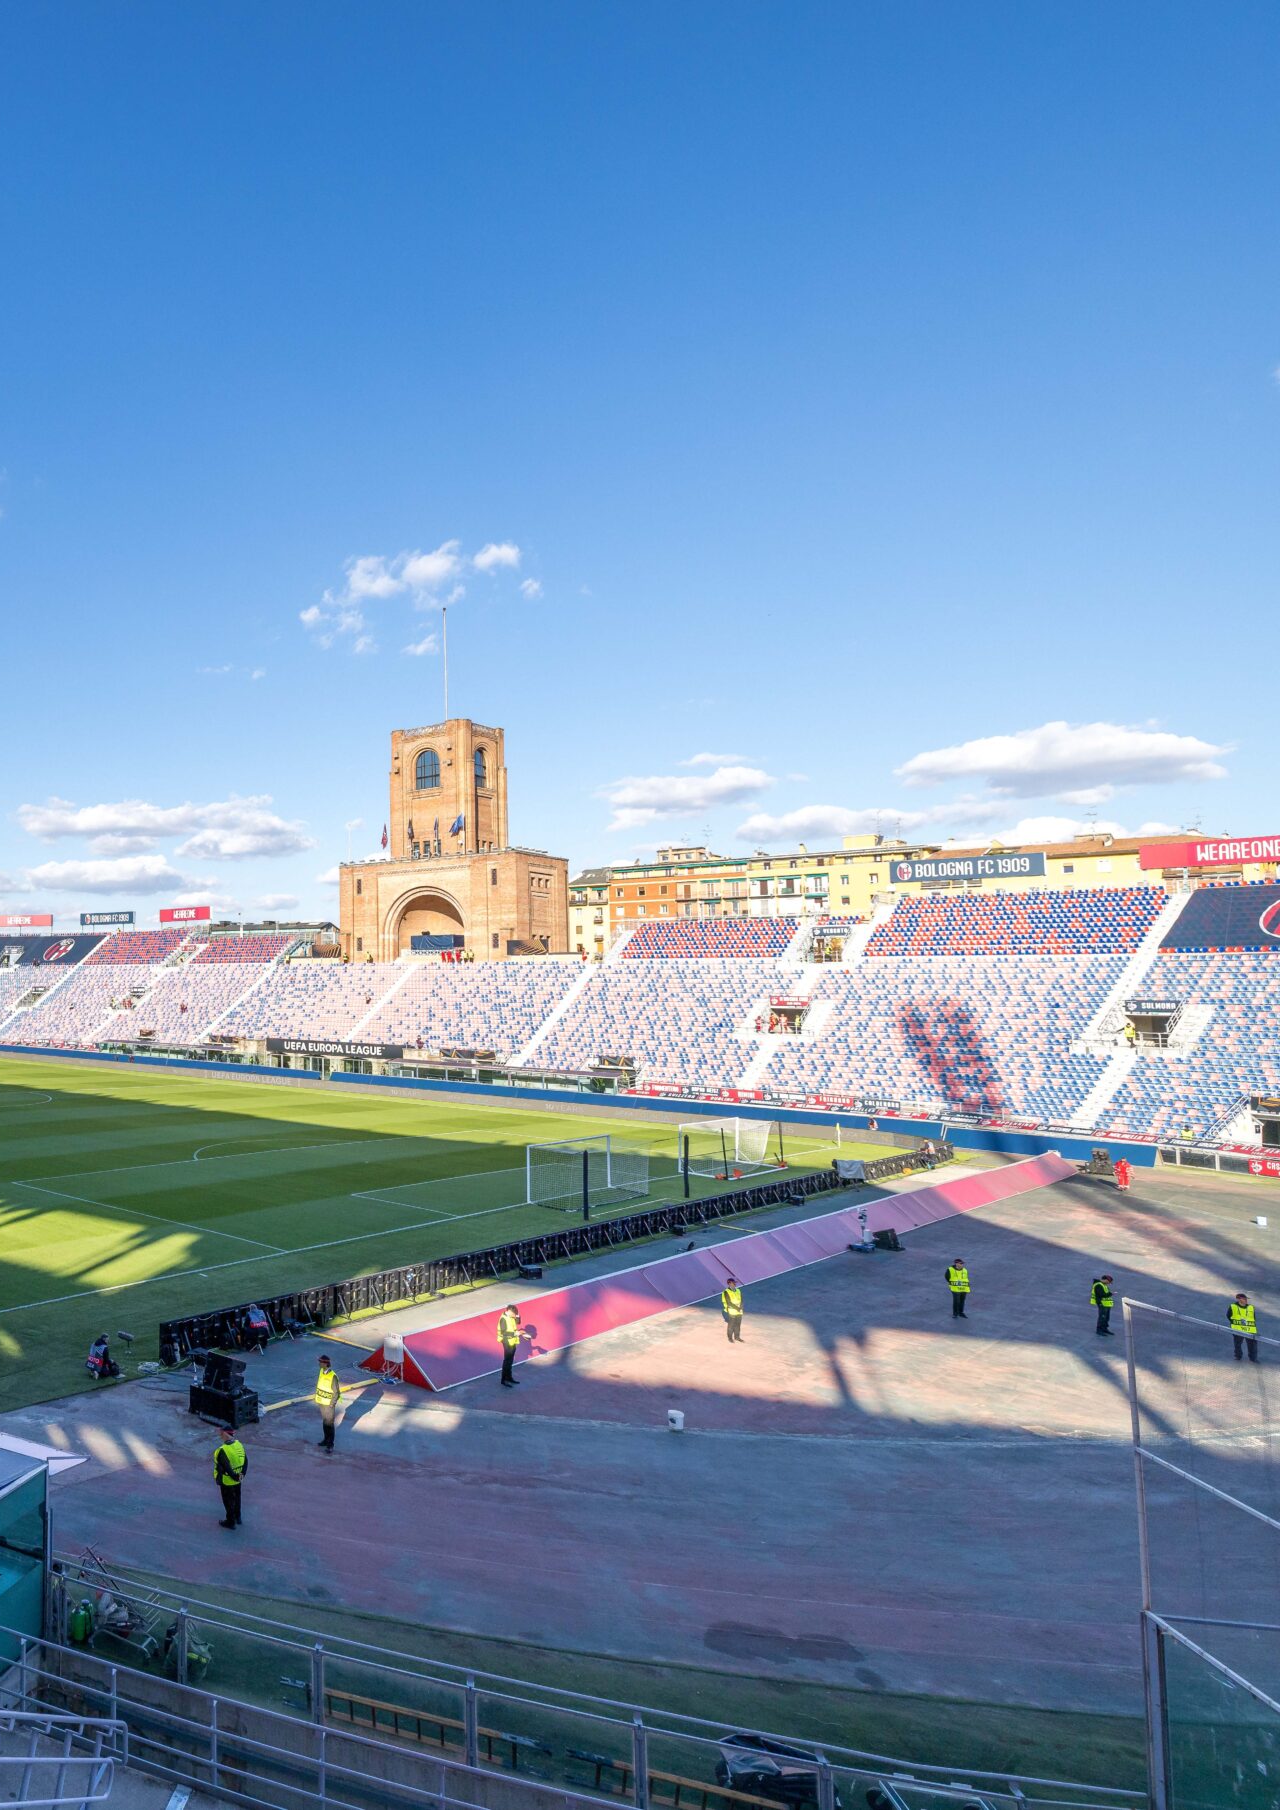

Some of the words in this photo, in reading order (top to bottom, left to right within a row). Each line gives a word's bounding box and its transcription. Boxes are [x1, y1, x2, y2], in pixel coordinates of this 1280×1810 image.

[1196, 838, 1280, 862] WEAREONE
[914, 860, 974, 878] BOLOGNA
[977, 860, 994, 874] FC
[996, 858, 1030, 873] 1909
[92, 914, 112, 923] BOLOGNA
[112, 914, 118, 922] FC
[118, 914, 130, 922] 1909
[1141, 1002, 1176, 1010] SULMONA
[284, 1041, 306, 1051] UEFA
[308, 1042, 344, 1053] EUROPA
[346, 1045, 382, 1056] LEAGUE
